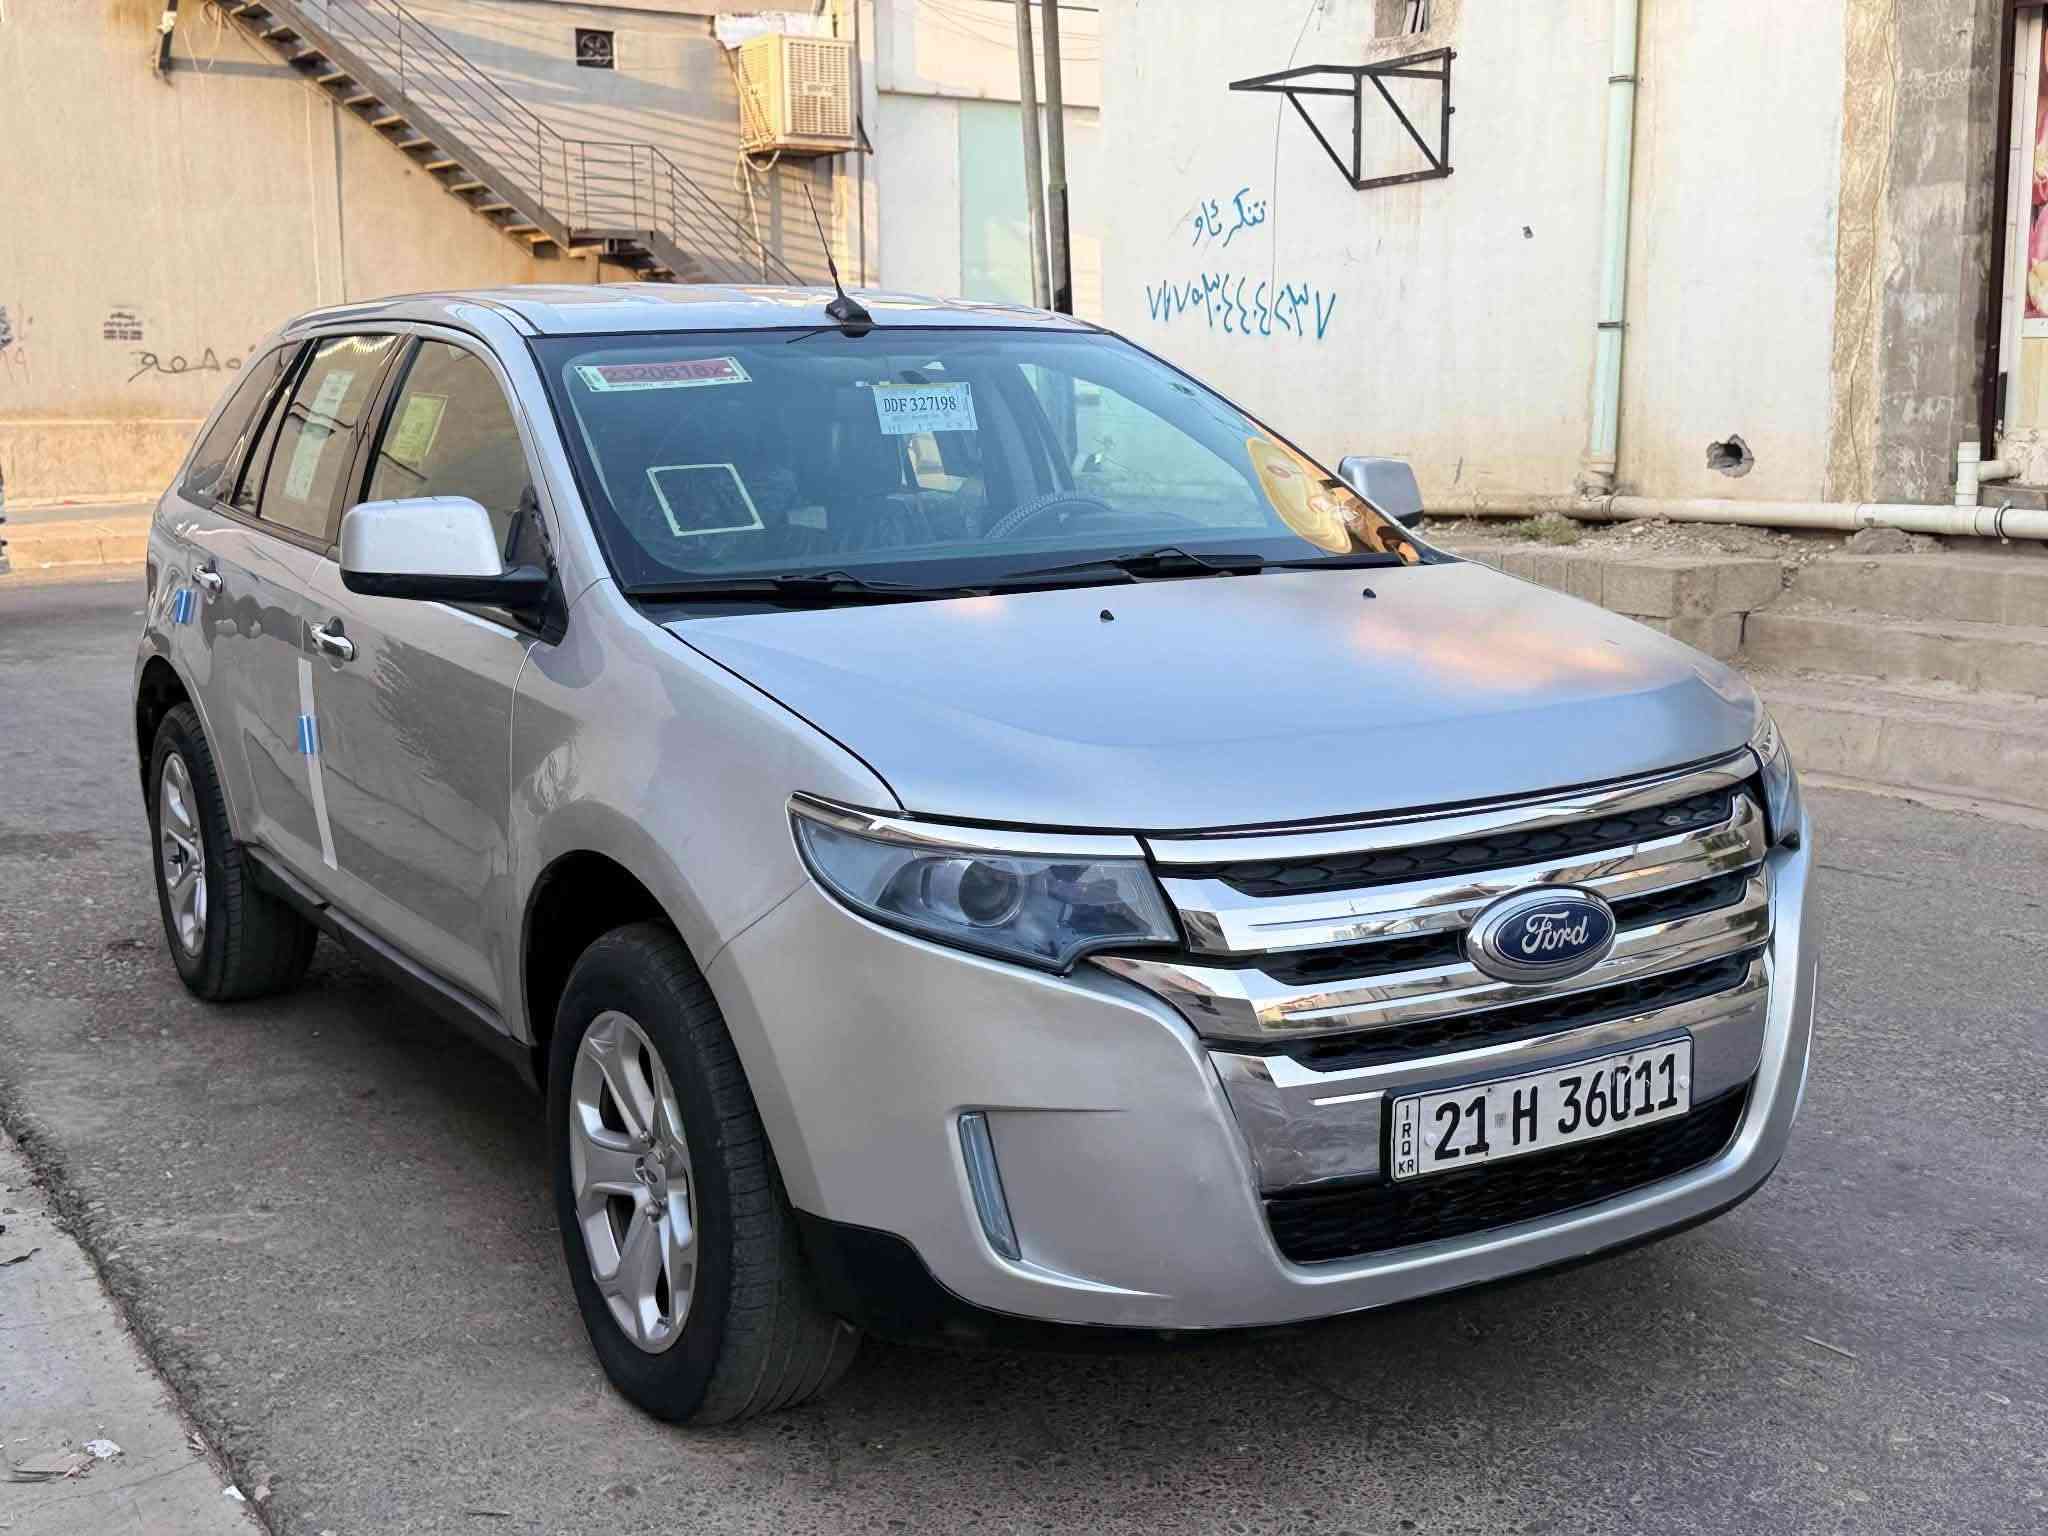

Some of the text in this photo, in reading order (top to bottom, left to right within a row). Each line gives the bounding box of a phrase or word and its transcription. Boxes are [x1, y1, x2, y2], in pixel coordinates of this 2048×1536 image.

[883, 396, 957, 412] DDF 327198
[1521, 911, 1588, 954] Ford
[1434, 1054, 1678, 1161] 21 H 36011
[1398, 1159, 1414, 1175] KR
